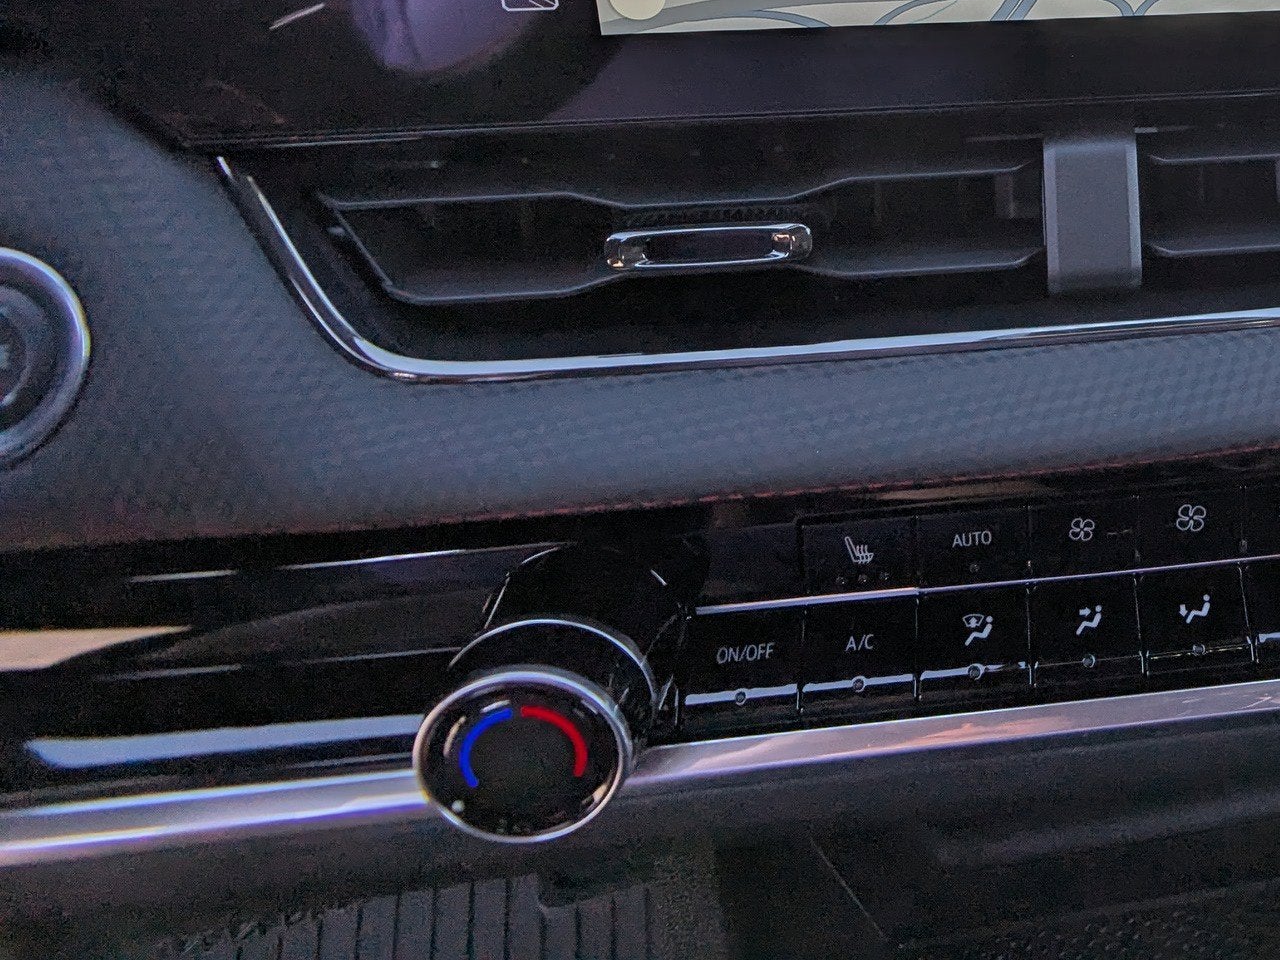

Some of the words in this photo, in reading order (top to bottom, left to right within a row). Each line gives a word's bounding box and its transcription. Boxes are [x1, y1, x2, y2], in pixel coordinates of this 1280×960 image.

[952, 530, 993, 548] AUTO
[846, 633, 874, 652] A/C
[716, 642, 775, 664] ON/OFF
